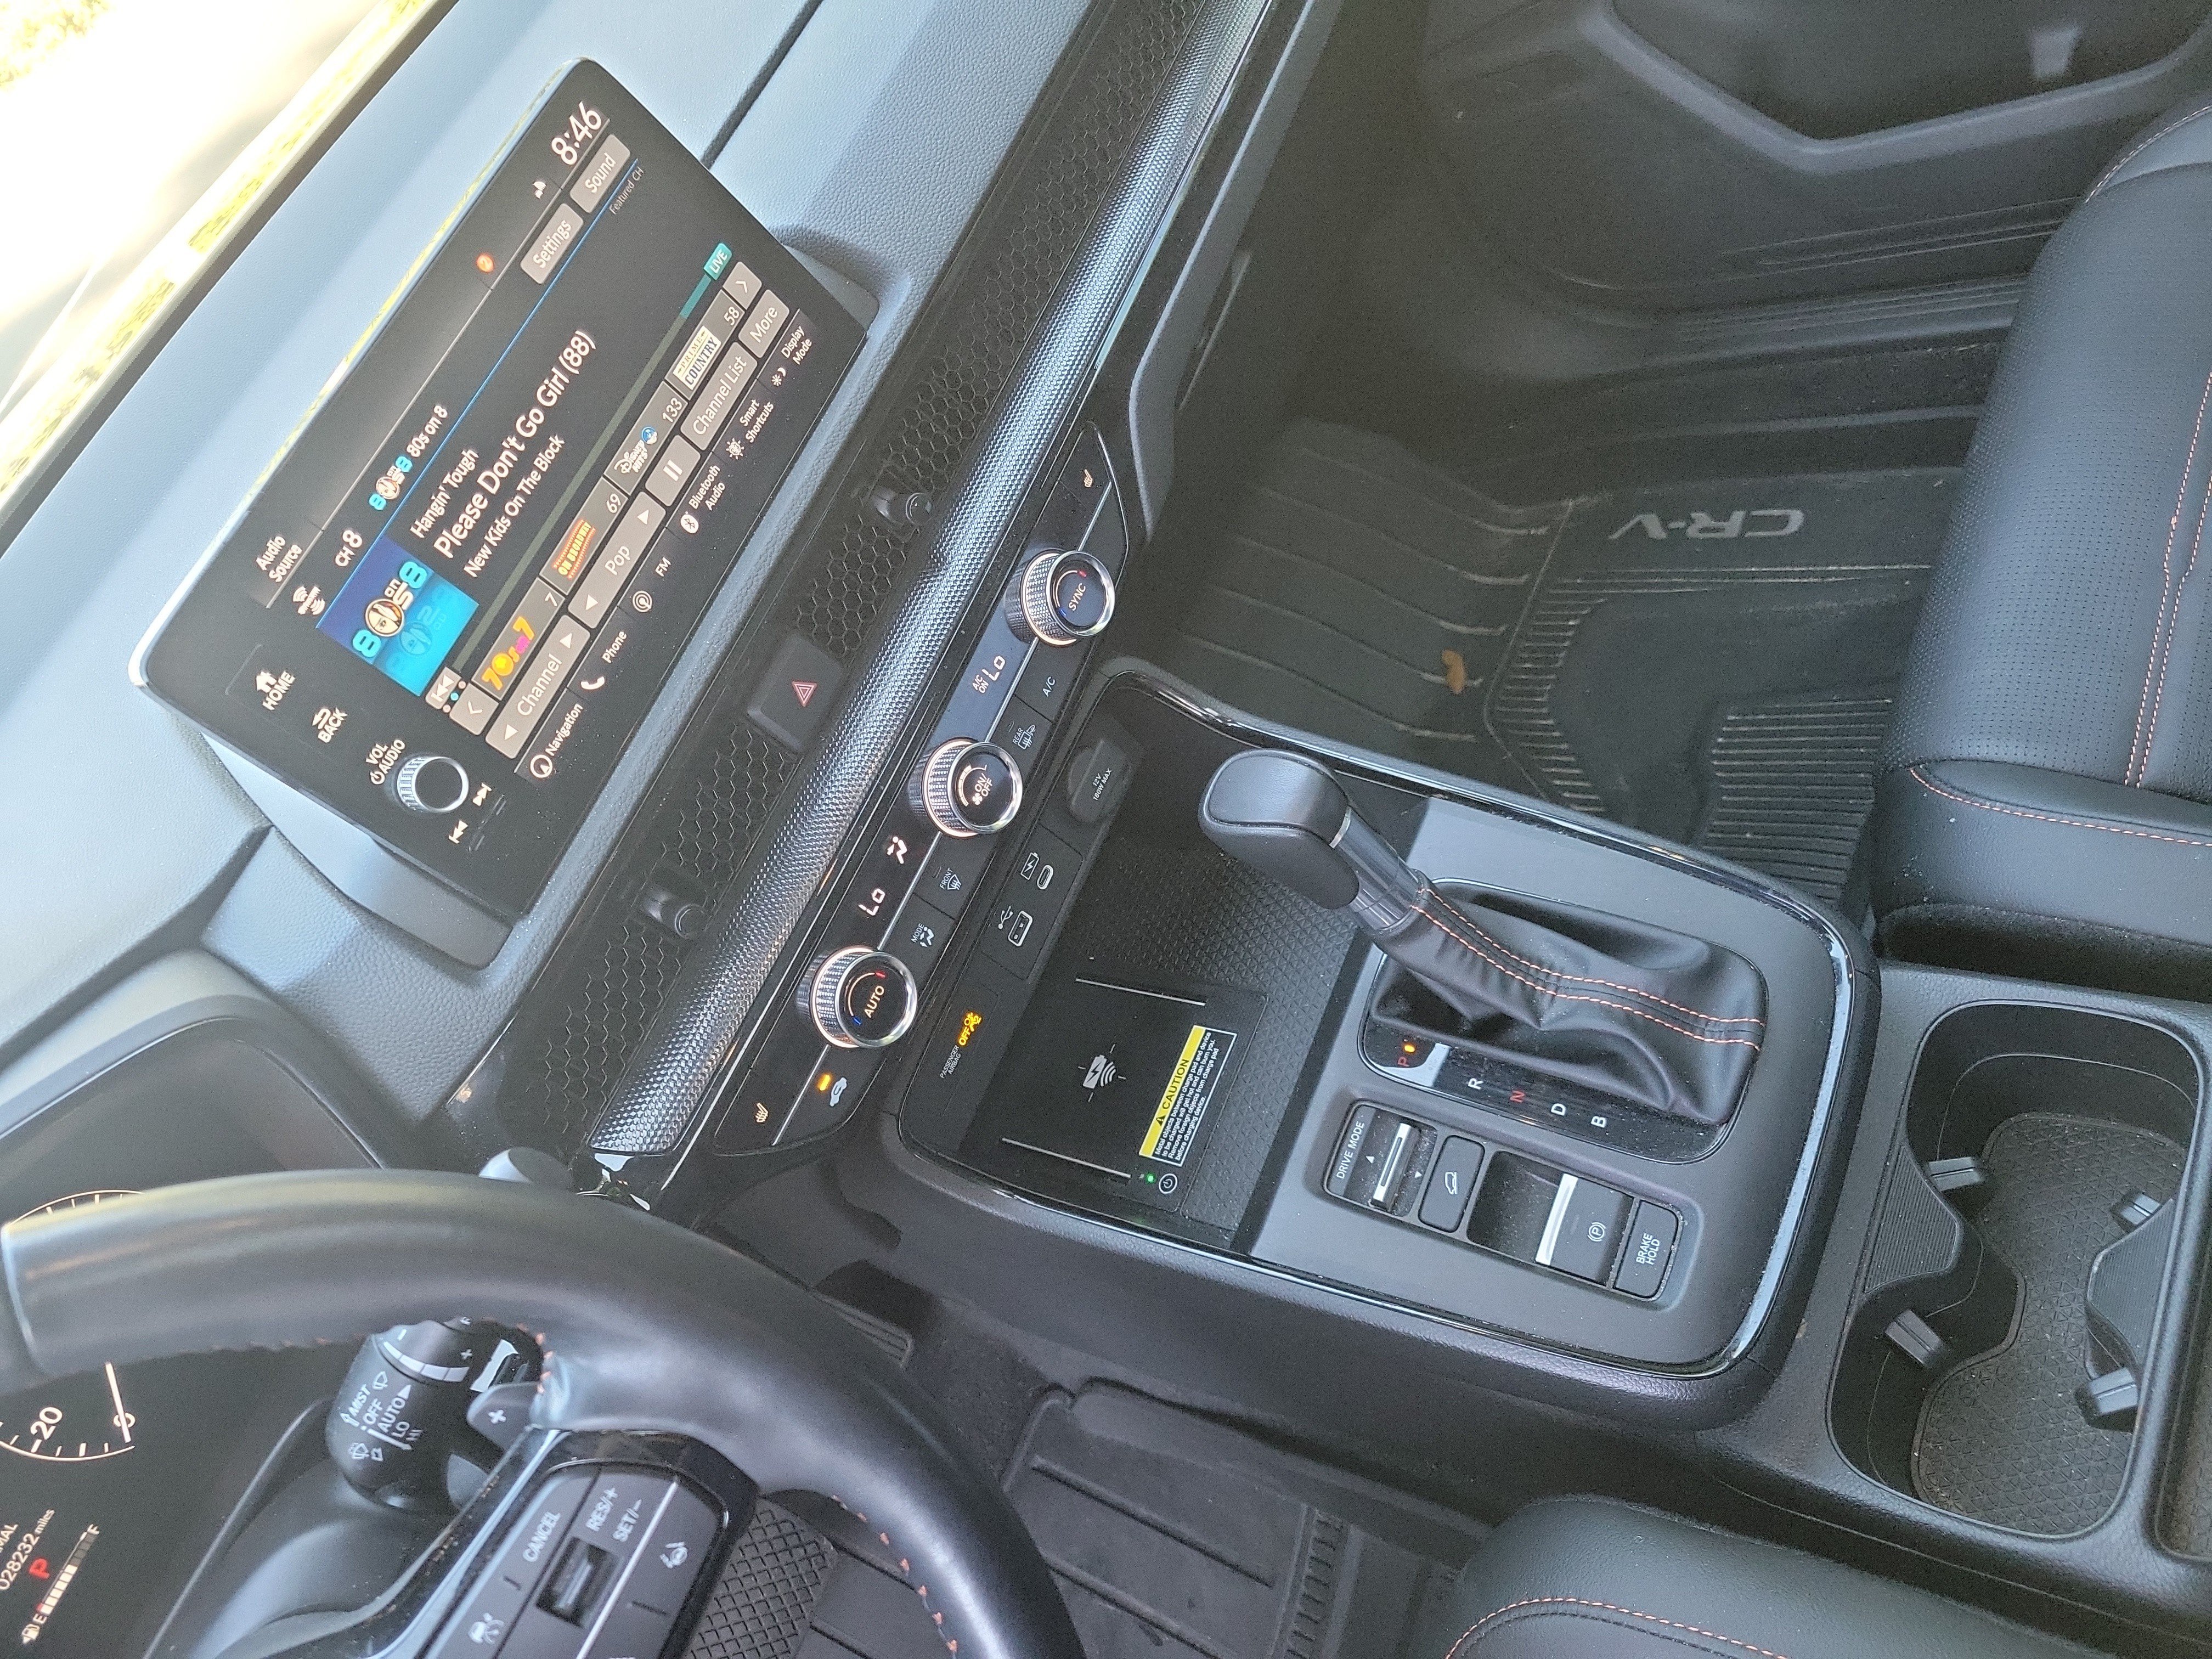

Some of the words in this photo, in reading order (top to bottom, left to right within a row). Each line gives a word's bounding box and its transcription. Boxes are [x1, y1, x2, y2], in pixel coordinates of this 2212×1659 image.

[551, 101, 601, 165] 8:46
[585, 153, 616, 193] Sound
[610, 181, 634, 215] Featured
[633, 167, 644, 182] CH
[533, 220, 571, 268] Settings
[709, 251, 727, 273] LIVE
[724, 307, 739, 326] 58
[750, 307, 777, 343] More
[680, 336, 702, 368] PRIME
[781, 326, 805, 358] Display
[792, 338, 812, 365] Mode
[685, 337, 718, 385] COUNTRY
[693, 381, 732, 435] Channel
[727, 356, 747, 386] List
[433, 405, 448, 419] 8
[663, 398, 682, 422] 133
[740, 399, 760, 426] Smart
[746, 402, 774, 443] Shortcuts
[425, 416, 442, 435] on
[407, 432, 431, 458] 80s
[434, 493, 488, 558] Please
[477, 436, 525, 494] Don't
[516, 409, 544, 437] Go
[537, 367, 569, 407] Girl
[558, 330, 596, 374] (88)
[396, 456, 413, 472] 8
[633, 450, 648, 472] HITS
[410, 485, 451, 538] Hangin'
[443, 449, 478, 488] Tough
[689, 465, 720, 509] Bluetooth
[705, 483, 725, 511] Audio
[464, 540, 492, 577] New
[488, 515, 510, 546] Kids
[505, 494, 526, 516] On
[517, 467, 541, 494] The
[534, 434, 565, 472] Block
[606, 493, 622, 514] 69
[1608, 509, 1804, 540] CR-V
[342, 529, 363, 548] 8
[256, 535, 286, 571] Audio
[268, 544, 302, 583] Source
[335, 546, 356, 567] CH
[605, 546, 630, 575] Pop
[399, 562, 427, 589] 8
[655, 557, 671, 577] FM
[545, 592, 557, 607] 7
[1068, 583, 1086, 611] SYNC
[603, 631, 627, 663] Phone
[263, 671, 296, 711] HOME
[517, 654, 562, 716] Channel
[973, 675, 984, 691] A/C
[979, 680, 989, 693] ON
[1042, 676, 1056, 697] A/C
[318, 708, 347, 743] BACK
[545, 703, 583, 757] Navigation
[1012, 727, 1024, 744] REAR
[366, 743, 388, 765] VOL
[381, 739, 405, 774] AUDIO
[975, 774, 987, 791] ON/
[981, 778, 994, 797] OFF
[1093, 772, 1101, 787] 12V
[1093, 783, 1104, 800] 180W
[1101, 768, 1112, 784] MAX
[940, 867, 952, 890] FRONT
[911, 923, 924, 943] MODE
[864, 985, 885, 1018] AUTO
[959, 1026, 970, 1046] OFF
[1206, 1039, 1216, 1052] you.
[940, 1045, 959, 1078] PASSENGER
[948, 1053, 961, 1075] AIRBAG
[1197, 1065, 1205, 1076] can
[1397, 1057, 1409, 1067] P
[1154, 1138, 1166, 1155] Metal
[1163, 1118, 1175, 1138] objects
[1170, 1093, 1186, 1118] between
[1182, 1073, 1194, 1093] charge
[1190, 1061, 1199, 1074] pad
[1195, 1050, 1204, 1062] and
[1200, 1032, 1211, 1050] device
[1162, 1059, 1189, 1109] CAUTION
[1186, 1087, 1195, 1098] hot
[1191, 1076, 1200, 1087] and
[1468, 1077, 1483, 1090] R
[1167, 1134, 1183, 1159] Remove
[1178, 1114, 1191, 1134] foreign
[1188, 1093, 1200, 1114] objects
[1195, 1079, 1206, 1093] from
[1202, 1059, 1214, 1079] charge
[1210, 1048, 1220, 1060] pad
[1183, 1097, 1191, 1108] get
[1510, 1090, 1525, 1103] N
[1550, 1103, 1566, 1115] D
[1169, 1117, 1182, 1142] charged
[1174, 1141, 1187, 1161] before
[1183, 1116, 1199, 1142] charging
[1194, 1096, 1207, 1116] device.
[1590, 1116, 1607, 1128] B
[1164, 1141, 1172, 1150] be
[1337, 1150, 1355, 1180] DRIVE
[1347, 1120, 1365, 1149] MODE
[1636, 1233, 1653, 1264] BRAKE
[1646, 1239, 1660, 1264] HOLD
[348, 1384, 371, 1417] MIST
[364, 1398, 383, 1425] OFF
[30, 1407, 63, 1440] 20
[113, 1413, 136, 1428] 0
[377, 1397, 405, 1432] AUTO
[392, 1421, 410, 1438] LO
[406, 1429, 423, 1441] HI
[87, 1523, 99, 1535] F
[523, 1511, 561, 1562] CANCEL
[0, 1533, 40, 1590] 028232
[35, 1509, 55, 1534] miles
[29, 1558, 50, 1579] P
[33, 1613, 47, 1624] E
